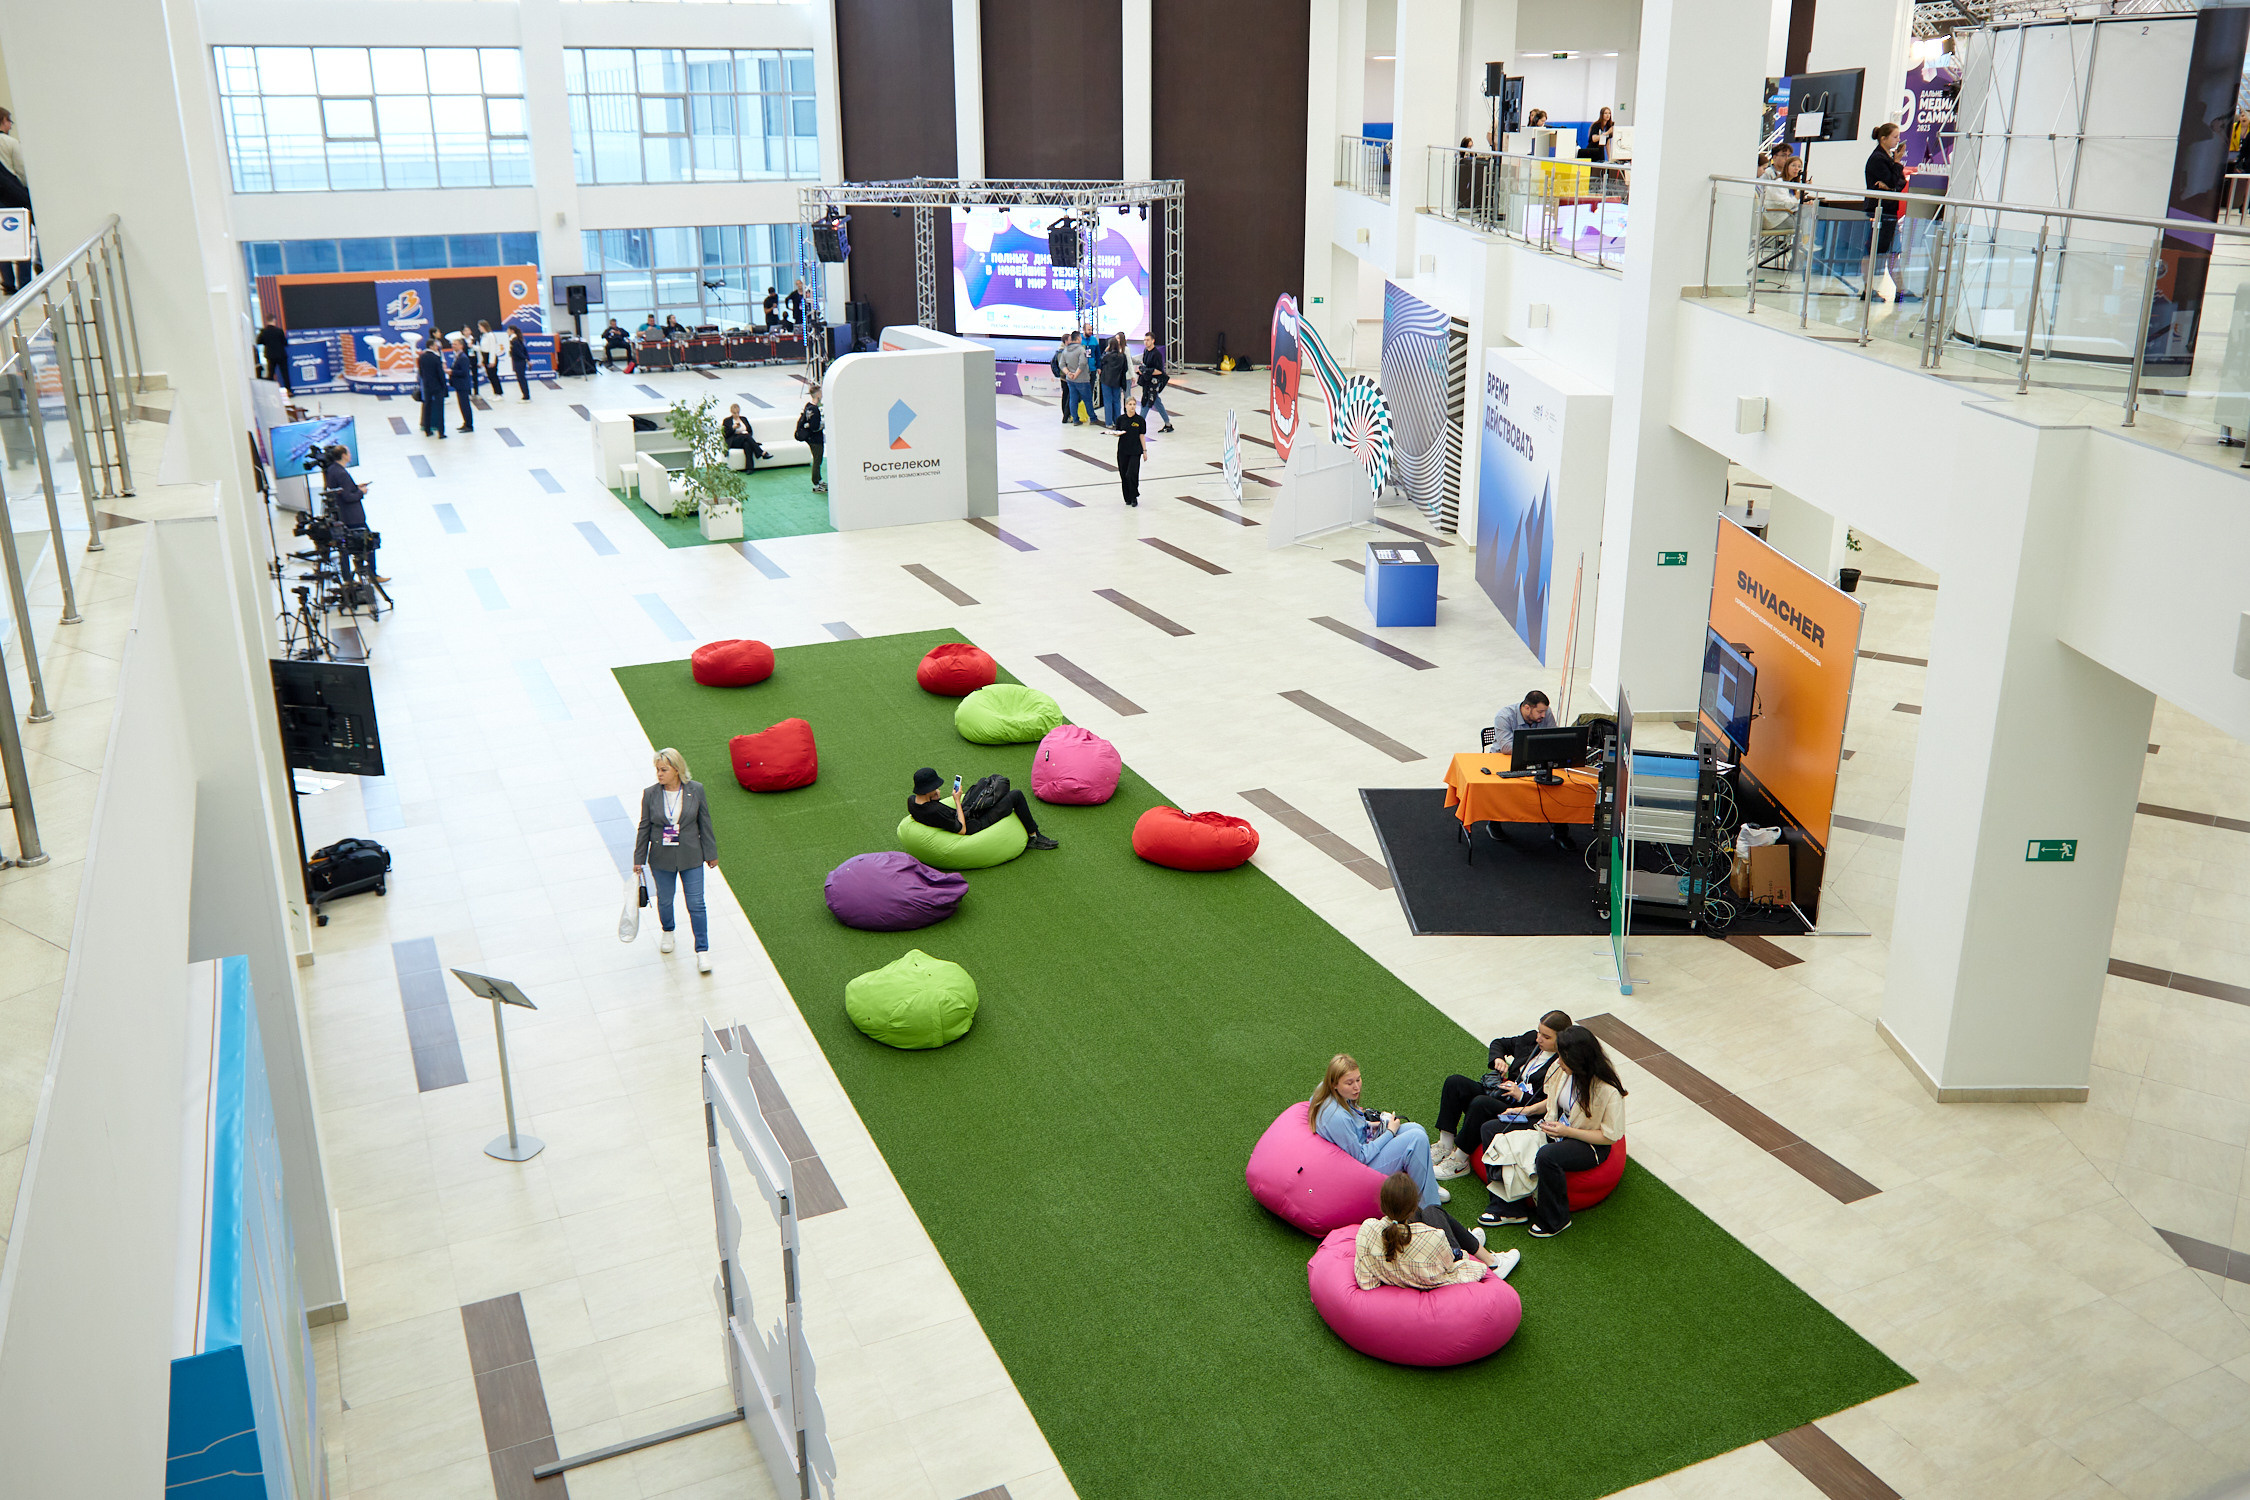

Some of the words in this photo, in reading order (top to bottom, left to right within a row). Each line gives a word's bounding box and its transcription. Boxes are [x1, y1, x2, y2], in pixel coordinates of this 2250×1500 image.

[1920, 90, 1943, 98] ДАЛЬНЕ
[1917, 111, 1958, 124] САММИ
[1917, 124, 1931, 132] 2023
[979, 253, 986, 263] 2
[991, 253, 1028, 264] ПОЛНЫХ
[985, 264, 993, 276] В
[998, 263, 1047, 277] НОВЕЙШИЕ
[1015, 278, 1023, 289] И
[1027, 279, 1047, 289] МИР
[1487, 371, 1510, 407] ВРЕМЯ
[1484, 405, 1535, 462] ДЕЙСТВОВАТЬ
[863, 458, 941, 473] Ростелеком
[864, 473, 898, 481] Технологии
[898, 470, 941, 479] возможностей
[1737, 569, 1825, 649] SHVACHER
